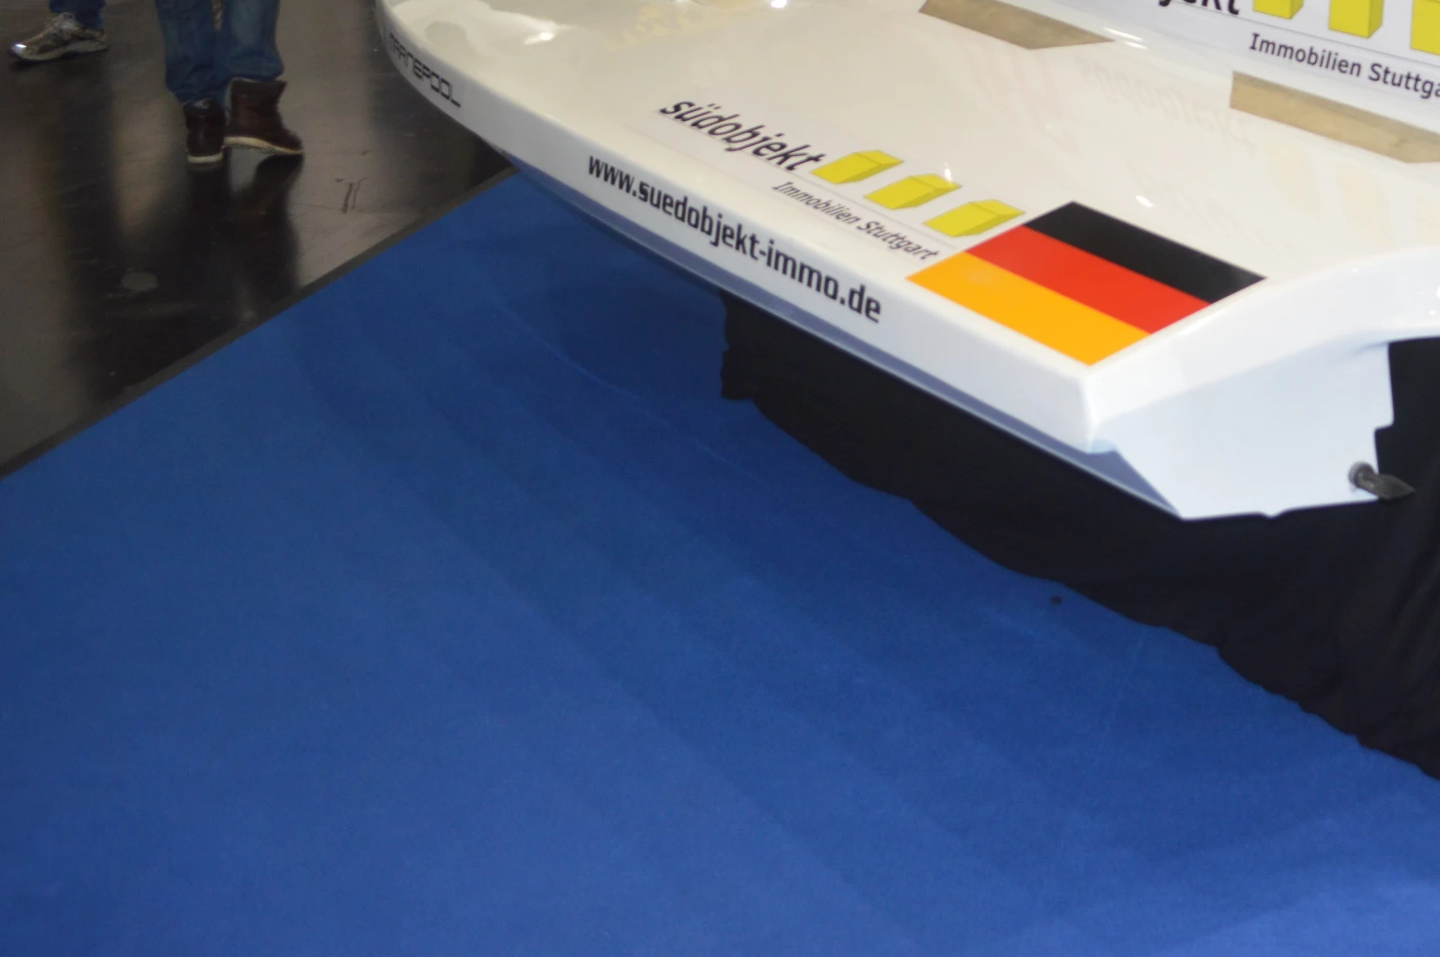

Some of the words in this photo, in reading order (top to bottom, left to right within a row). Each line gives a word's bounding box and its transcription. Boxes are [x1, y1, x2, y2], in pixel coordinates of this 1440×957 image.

[1249, 32, 1363, 77] Immobilien
[659, 99, 826, 172] südobjekt
[588, 155, 882, 324] www.suedobjekt-immo.de
[771, 180, 860, 226] Immobilien
[857, 219, 941, 261] Stuttgart
